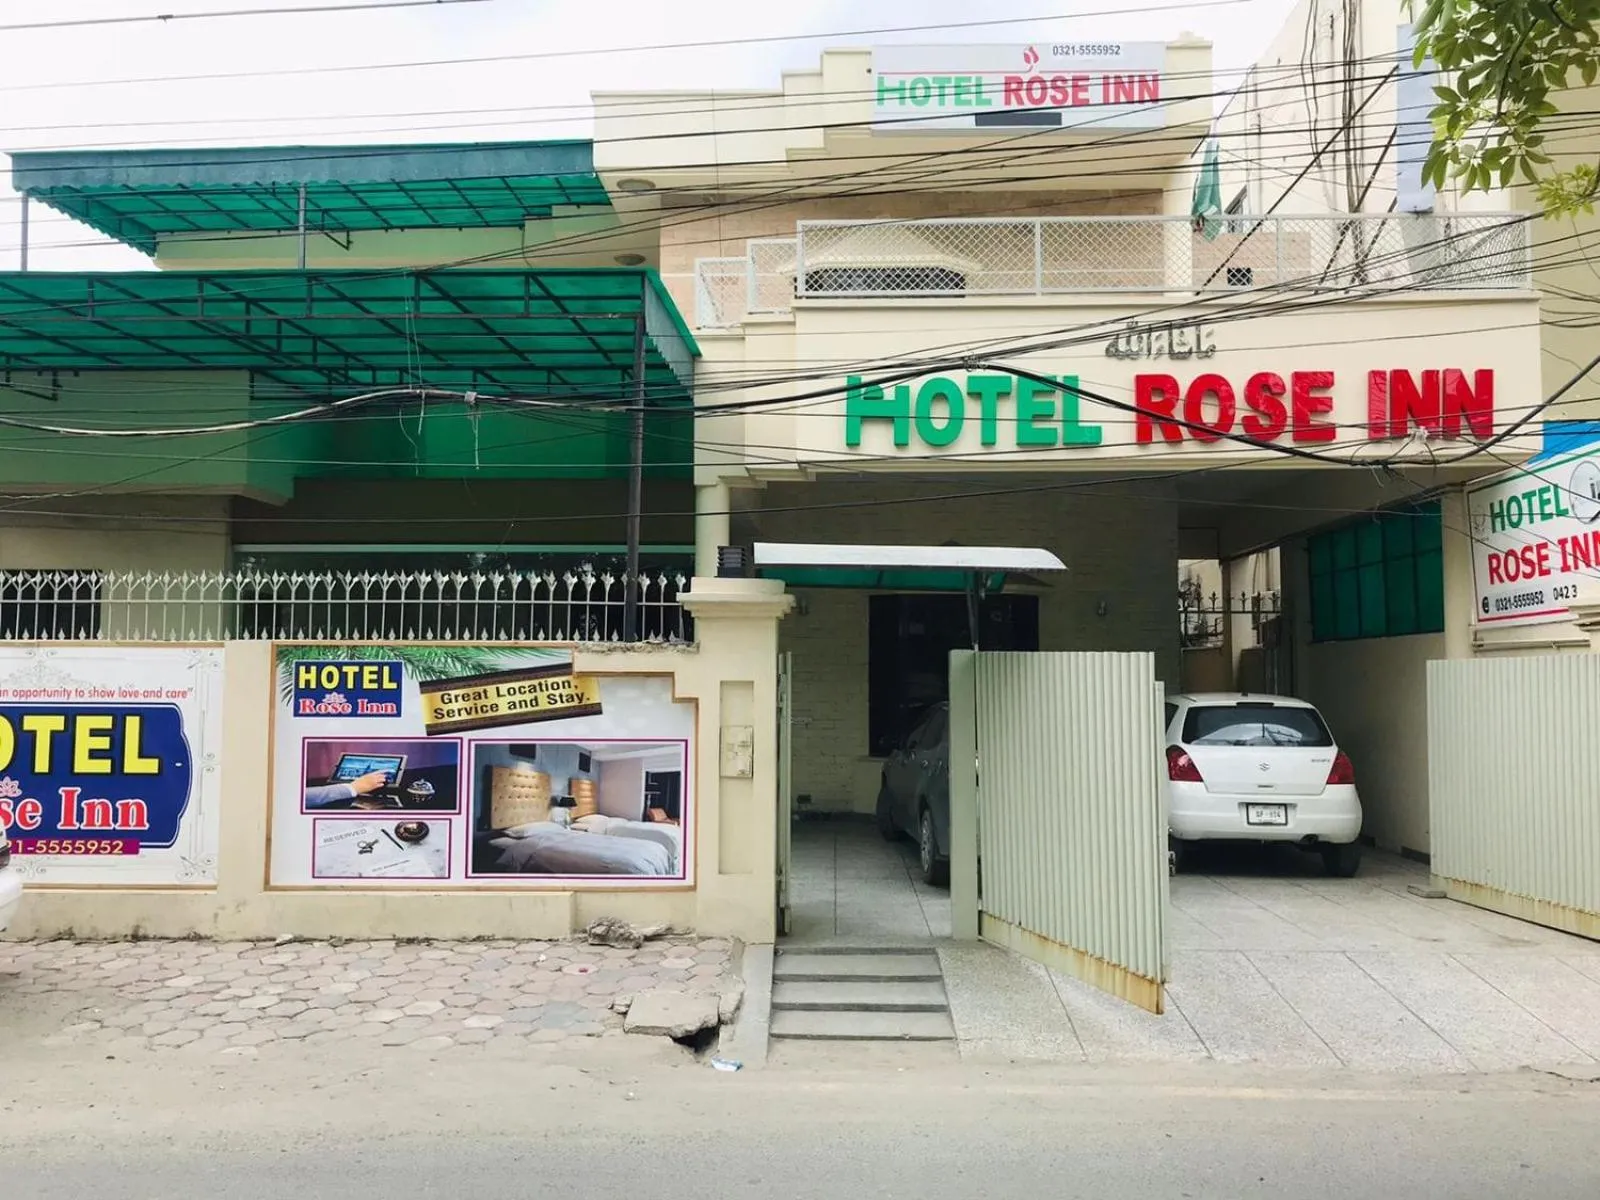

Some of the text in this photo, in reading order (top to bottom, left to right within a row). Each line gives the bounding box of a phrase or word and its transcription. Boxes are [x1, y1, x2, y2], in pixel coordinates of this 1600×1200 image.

[1052, 45, 1121, 56] 0321-5555952
[877, 74, 1160, 107] HOTEL ROSE INN
[845, 368, 1494, 448] HOTEL ROSE INN
[1489, 483, 1569, 534] HOTEL
[1487, 541, 1551, 585] ROSE
[1495, 591, 1545, 612] 0321-5555952
[298, 664, 397, 690] HOTEL
[12, 686, 72, 699] opportunity
[75, 687, 85, 698] to
[88, 686, 115, 698] show
[119, 686, 139, 699] love
[434, 691, 590, 720] Service and Stay.
[440, 679, 578, 705] Great Location,
[299, 698, 397, 715] Rose Inn
[57, 787, 149, 830] Inn
